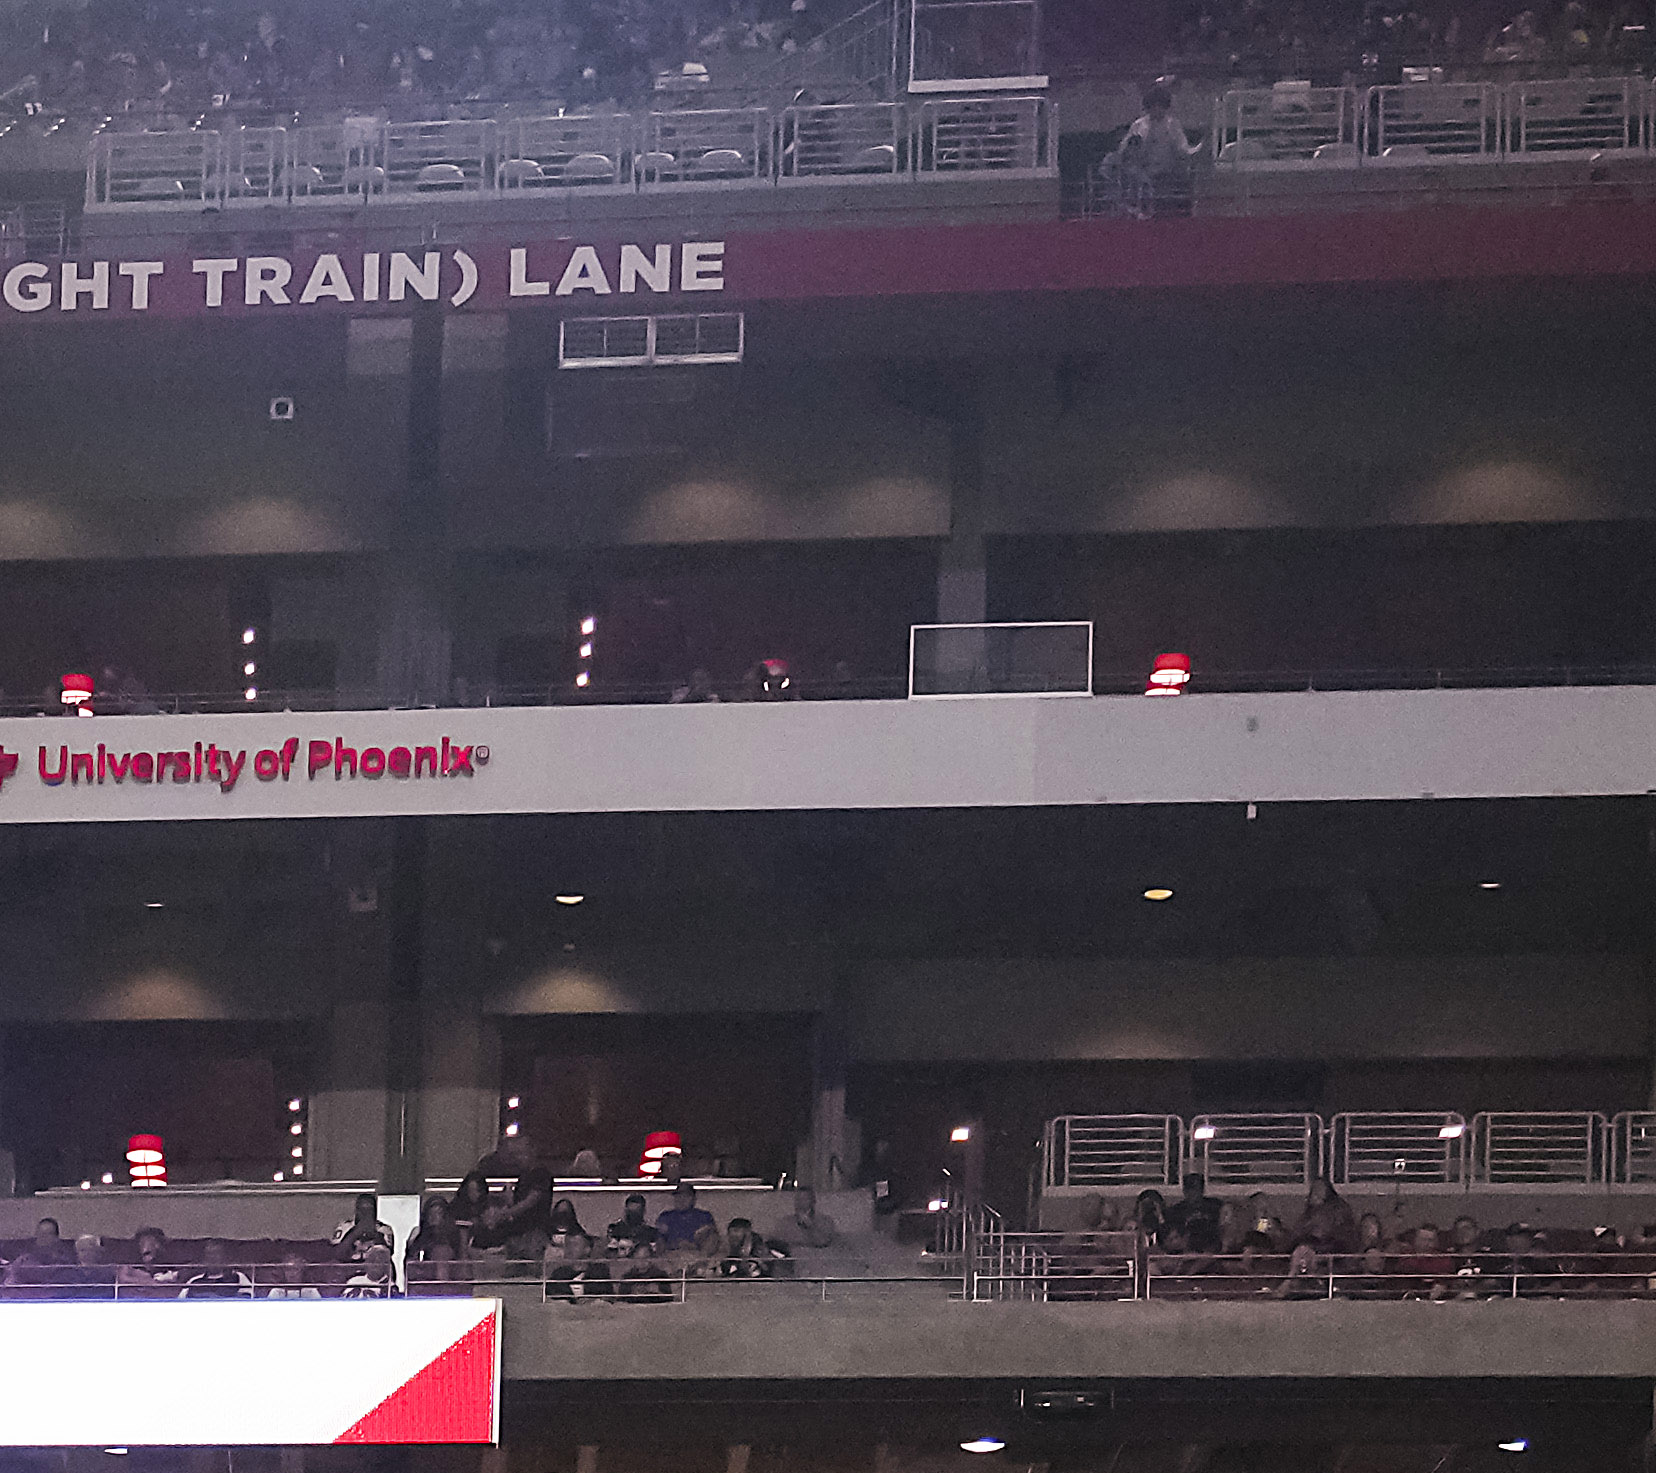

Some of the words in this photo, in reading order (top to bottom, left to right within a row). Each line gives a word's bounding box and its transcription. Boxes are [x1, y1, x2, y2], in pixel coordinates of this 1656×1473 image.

[192, 242, 478, 307] TRAIN)
[508, 240, 726, 298] LANE
[36, 742, 247, 790] University
[254, 737, 301, 781] of
